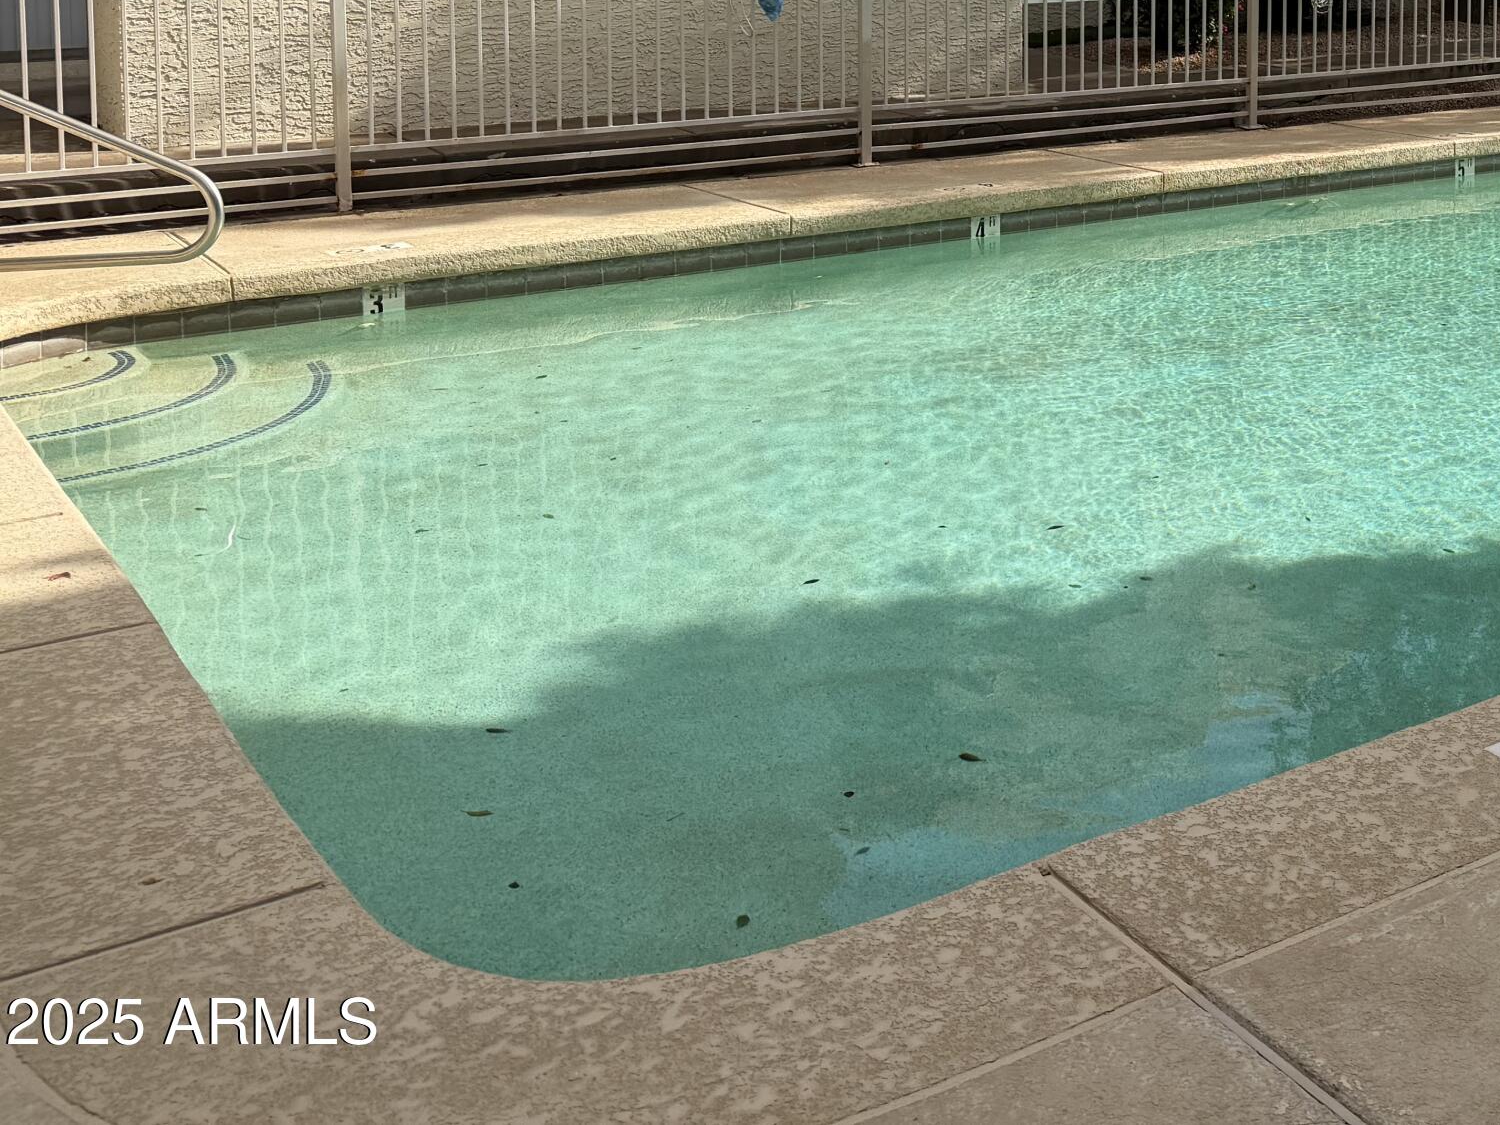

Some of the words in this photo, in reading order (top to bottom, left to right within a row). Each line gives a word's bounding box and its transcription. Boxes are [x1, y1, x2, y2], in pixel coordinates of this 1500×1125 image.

[1458, 159, 1465, 176] 5
[976, 217, 986, 237] 4
[369, 288, 384, 314] 3
